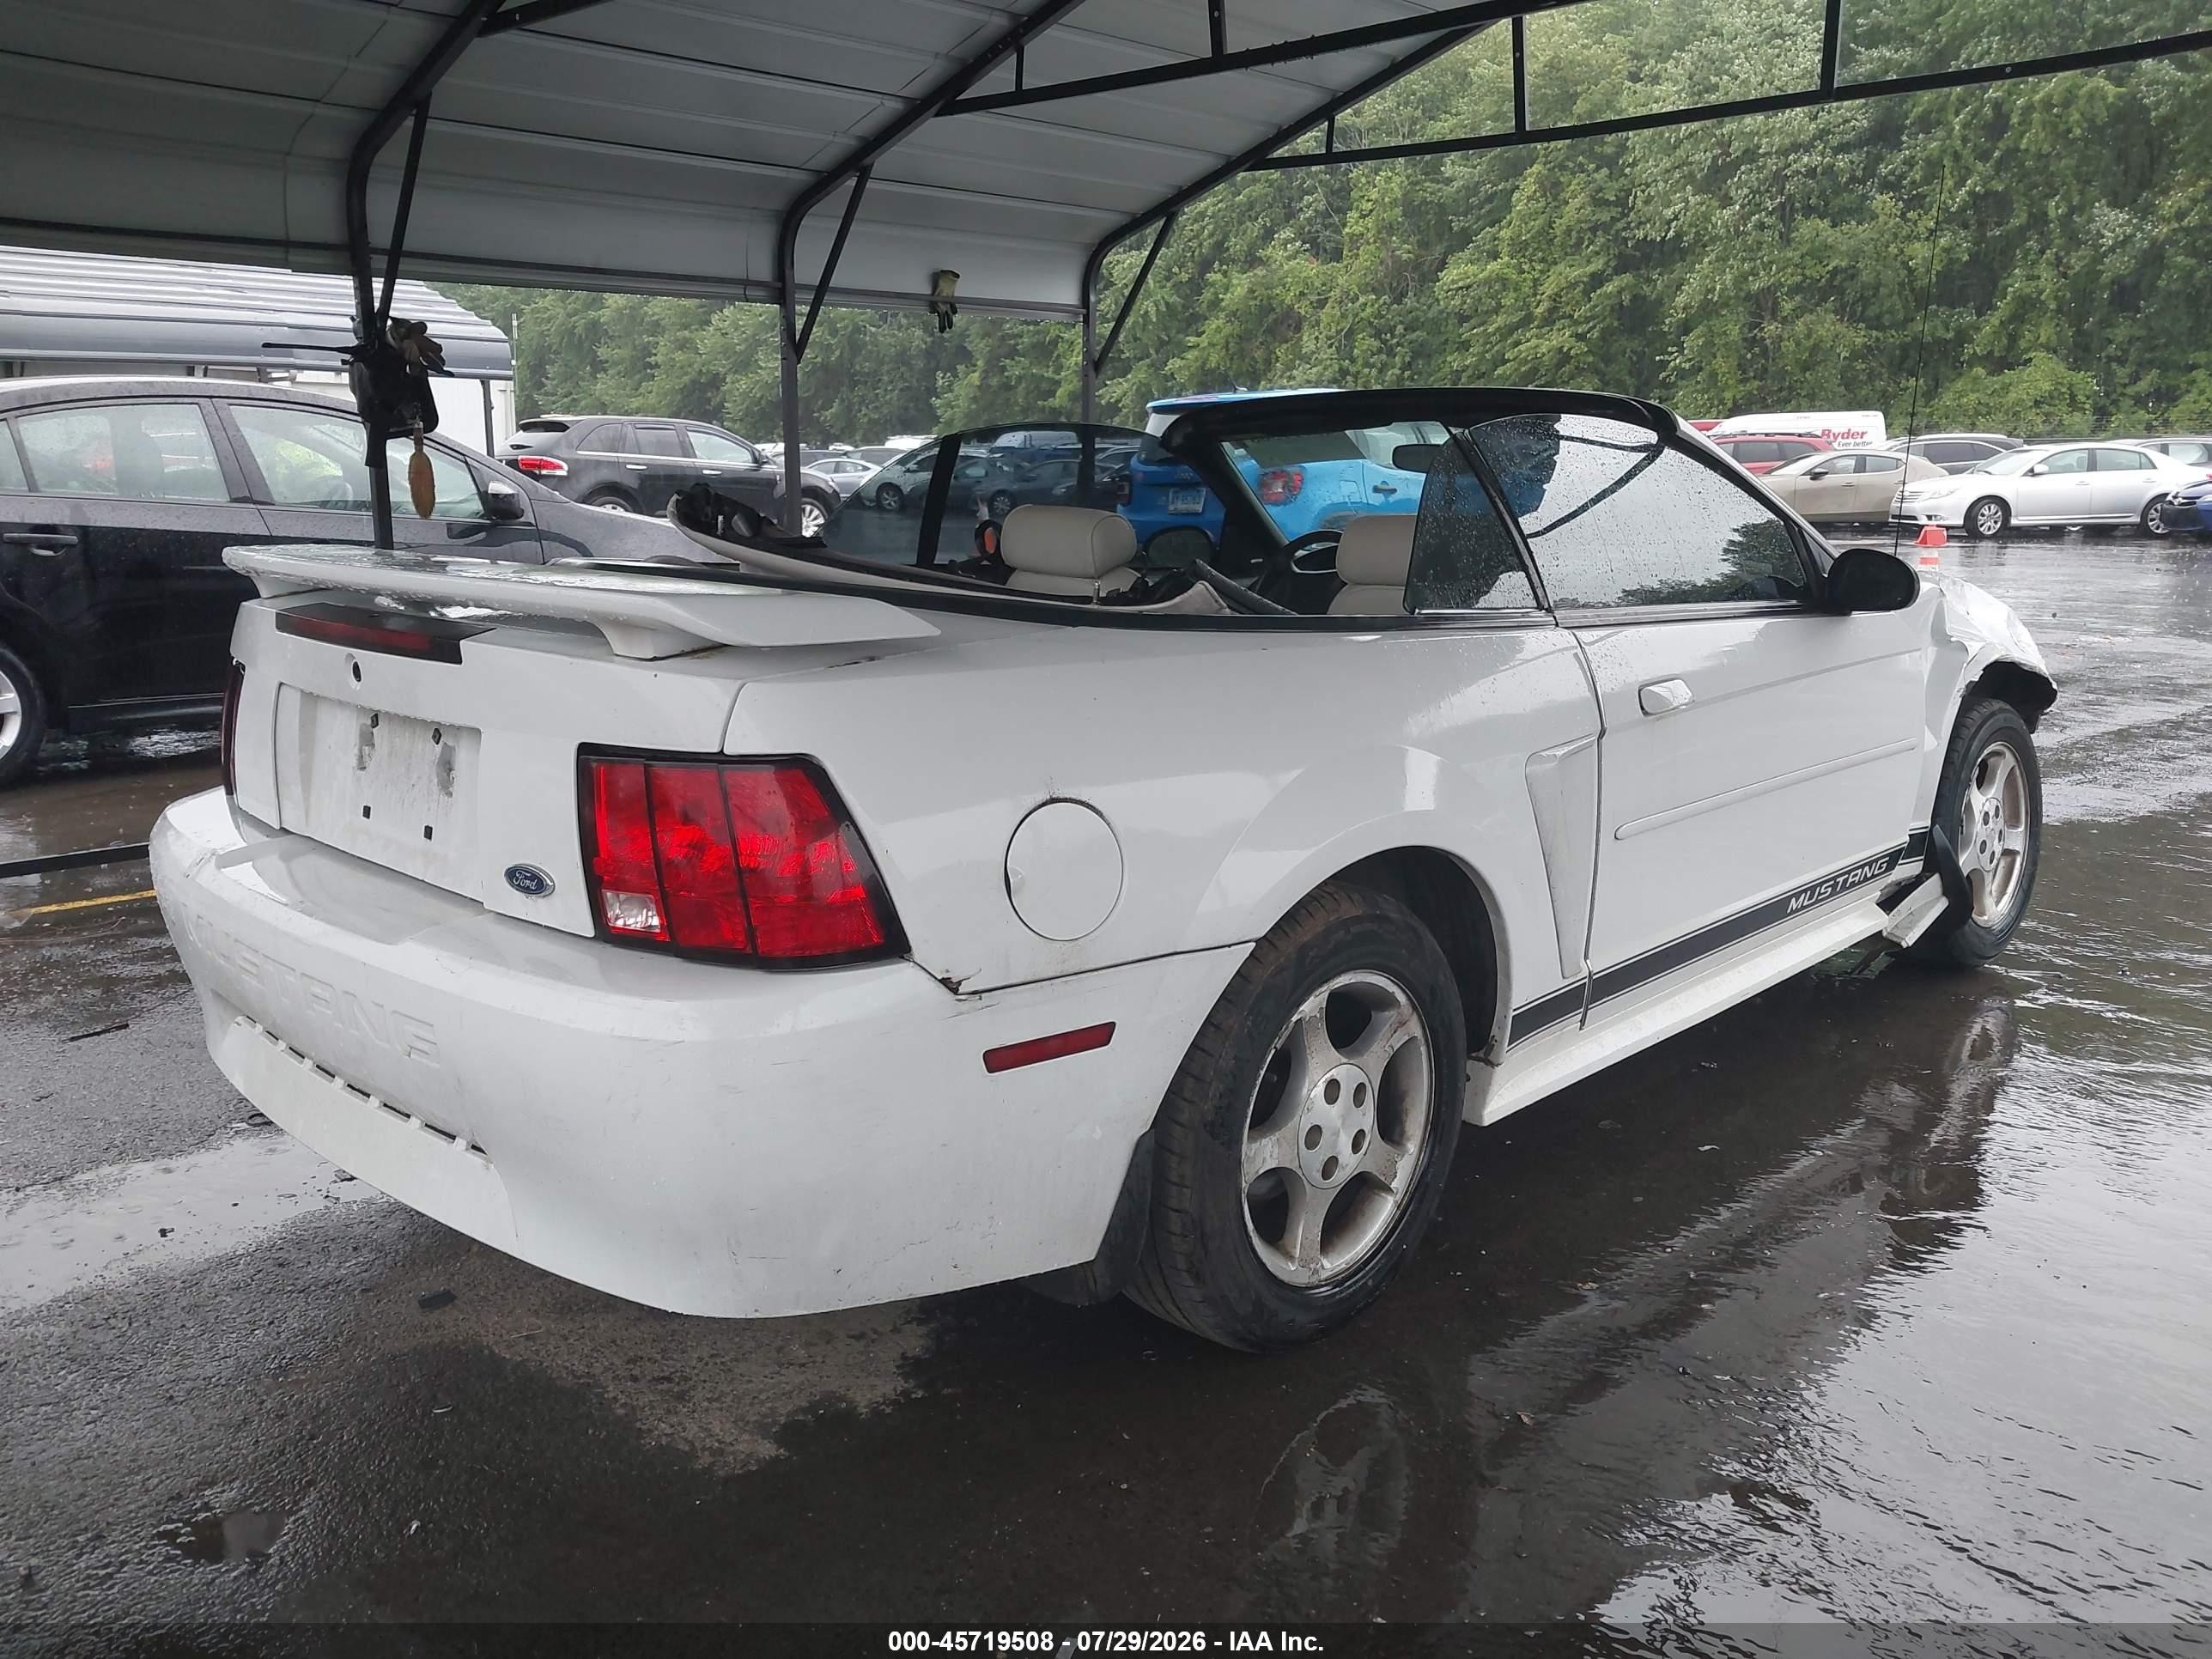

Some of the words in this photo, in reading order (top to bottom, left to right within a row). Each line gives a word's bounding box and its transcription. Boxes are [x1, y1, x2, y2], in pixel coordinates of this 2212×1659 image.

[1820, 428, 1867, 442] Ryder
[513, 870, 538, 890] Ford
[1786, 857, 1890, 914] MUSTANG
